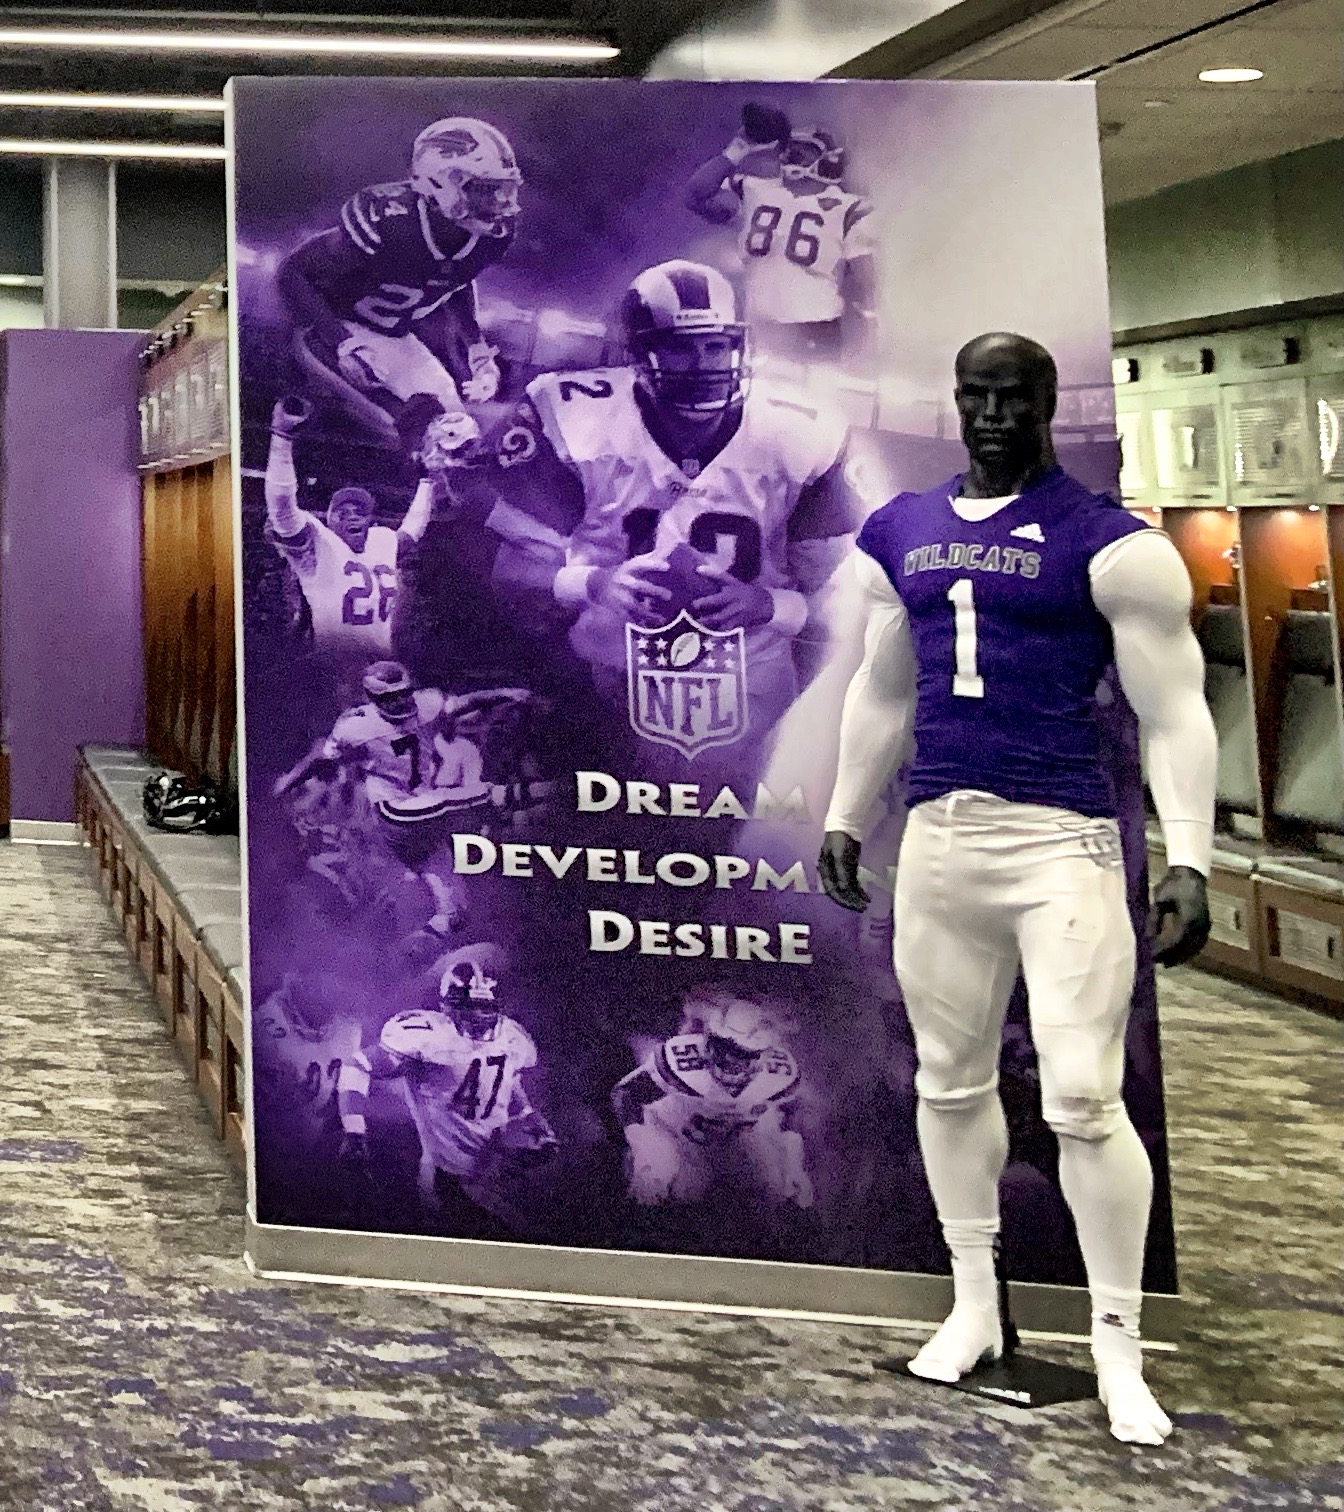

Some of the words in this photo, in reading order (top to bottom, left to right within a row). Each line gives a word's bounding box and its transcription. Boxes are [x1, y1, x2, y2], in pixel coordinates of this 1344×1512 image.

[745, 204, 825, 268] 86
[903, 542, 1043, 580] WILDCATS
[946, 578, 986, 699] 1
[641, 674, 735, 737] NFL
[574, 770, 813, 824] DREAM
[587, 909, 813, 965] DESIRE
[449, 1053, 508, 1121] 47
